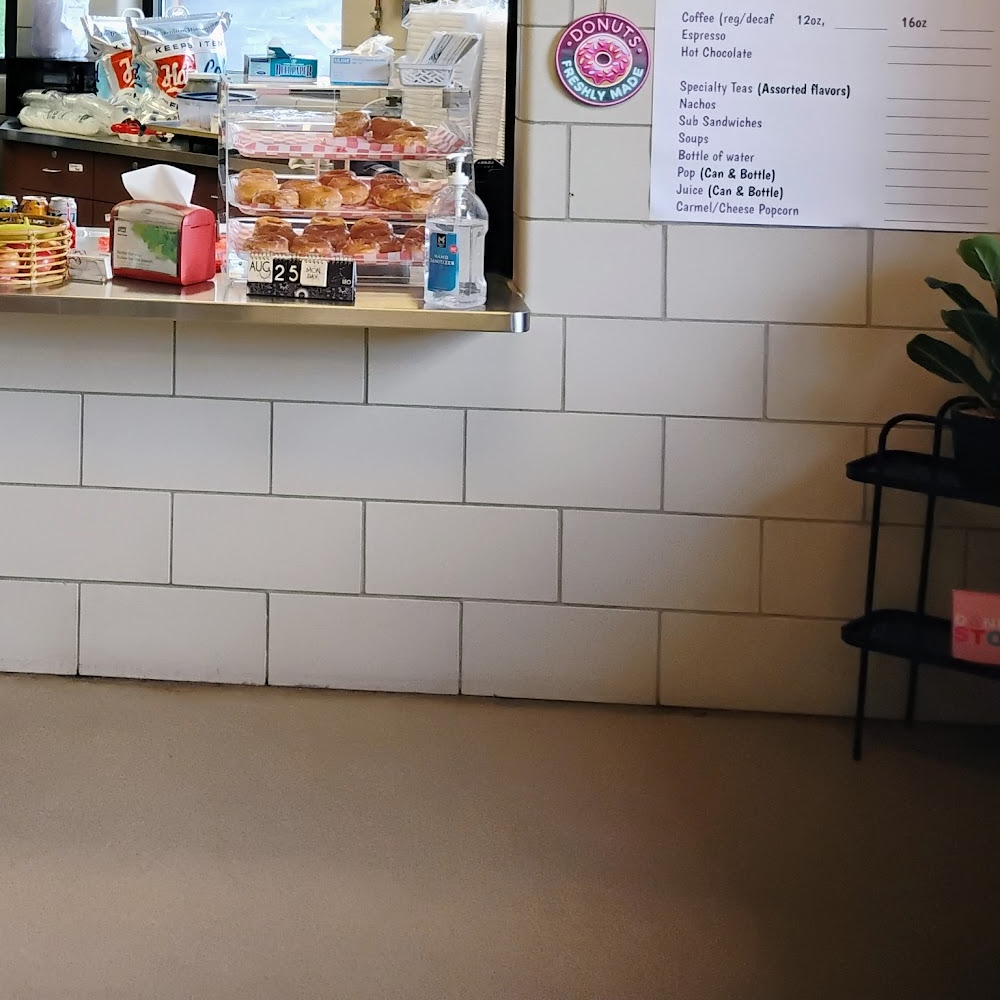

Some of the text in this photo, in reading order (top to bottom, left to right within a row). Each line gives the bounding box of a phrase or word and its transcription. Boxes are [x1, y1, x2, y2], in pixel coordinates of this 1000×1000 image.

[682, 12, 927, 28] Coffee (reg/decaf 12oz, 16oz
[569, 18, 641, 47] DONUTS
[682, 29, 725, 43] Espresso
[682, 47, 752, 58] Hot Chocolate
[562, 60, 644, 101] FRESHLY MADE
[680, 81, 850, 99] Specialty Teas (Assorted flavors)
[680, 98, 715, 109] Nachos
[679, 115, 762, 128] Sub Sandwiches
[679, 132, 708, 146] Soups
[679, 150, 754, 162] Bottle of water
[678, 166, 775, 182] Pop (Can & Bottle)
[676, 184, 783, 200] Juice (Can & Bottle)
[676, 201, 798, 218] Carmel/Cheese Popcorn
[430, 258, 455, 266] SANITIZER
[249, 261, 299, 282] AUG 25
